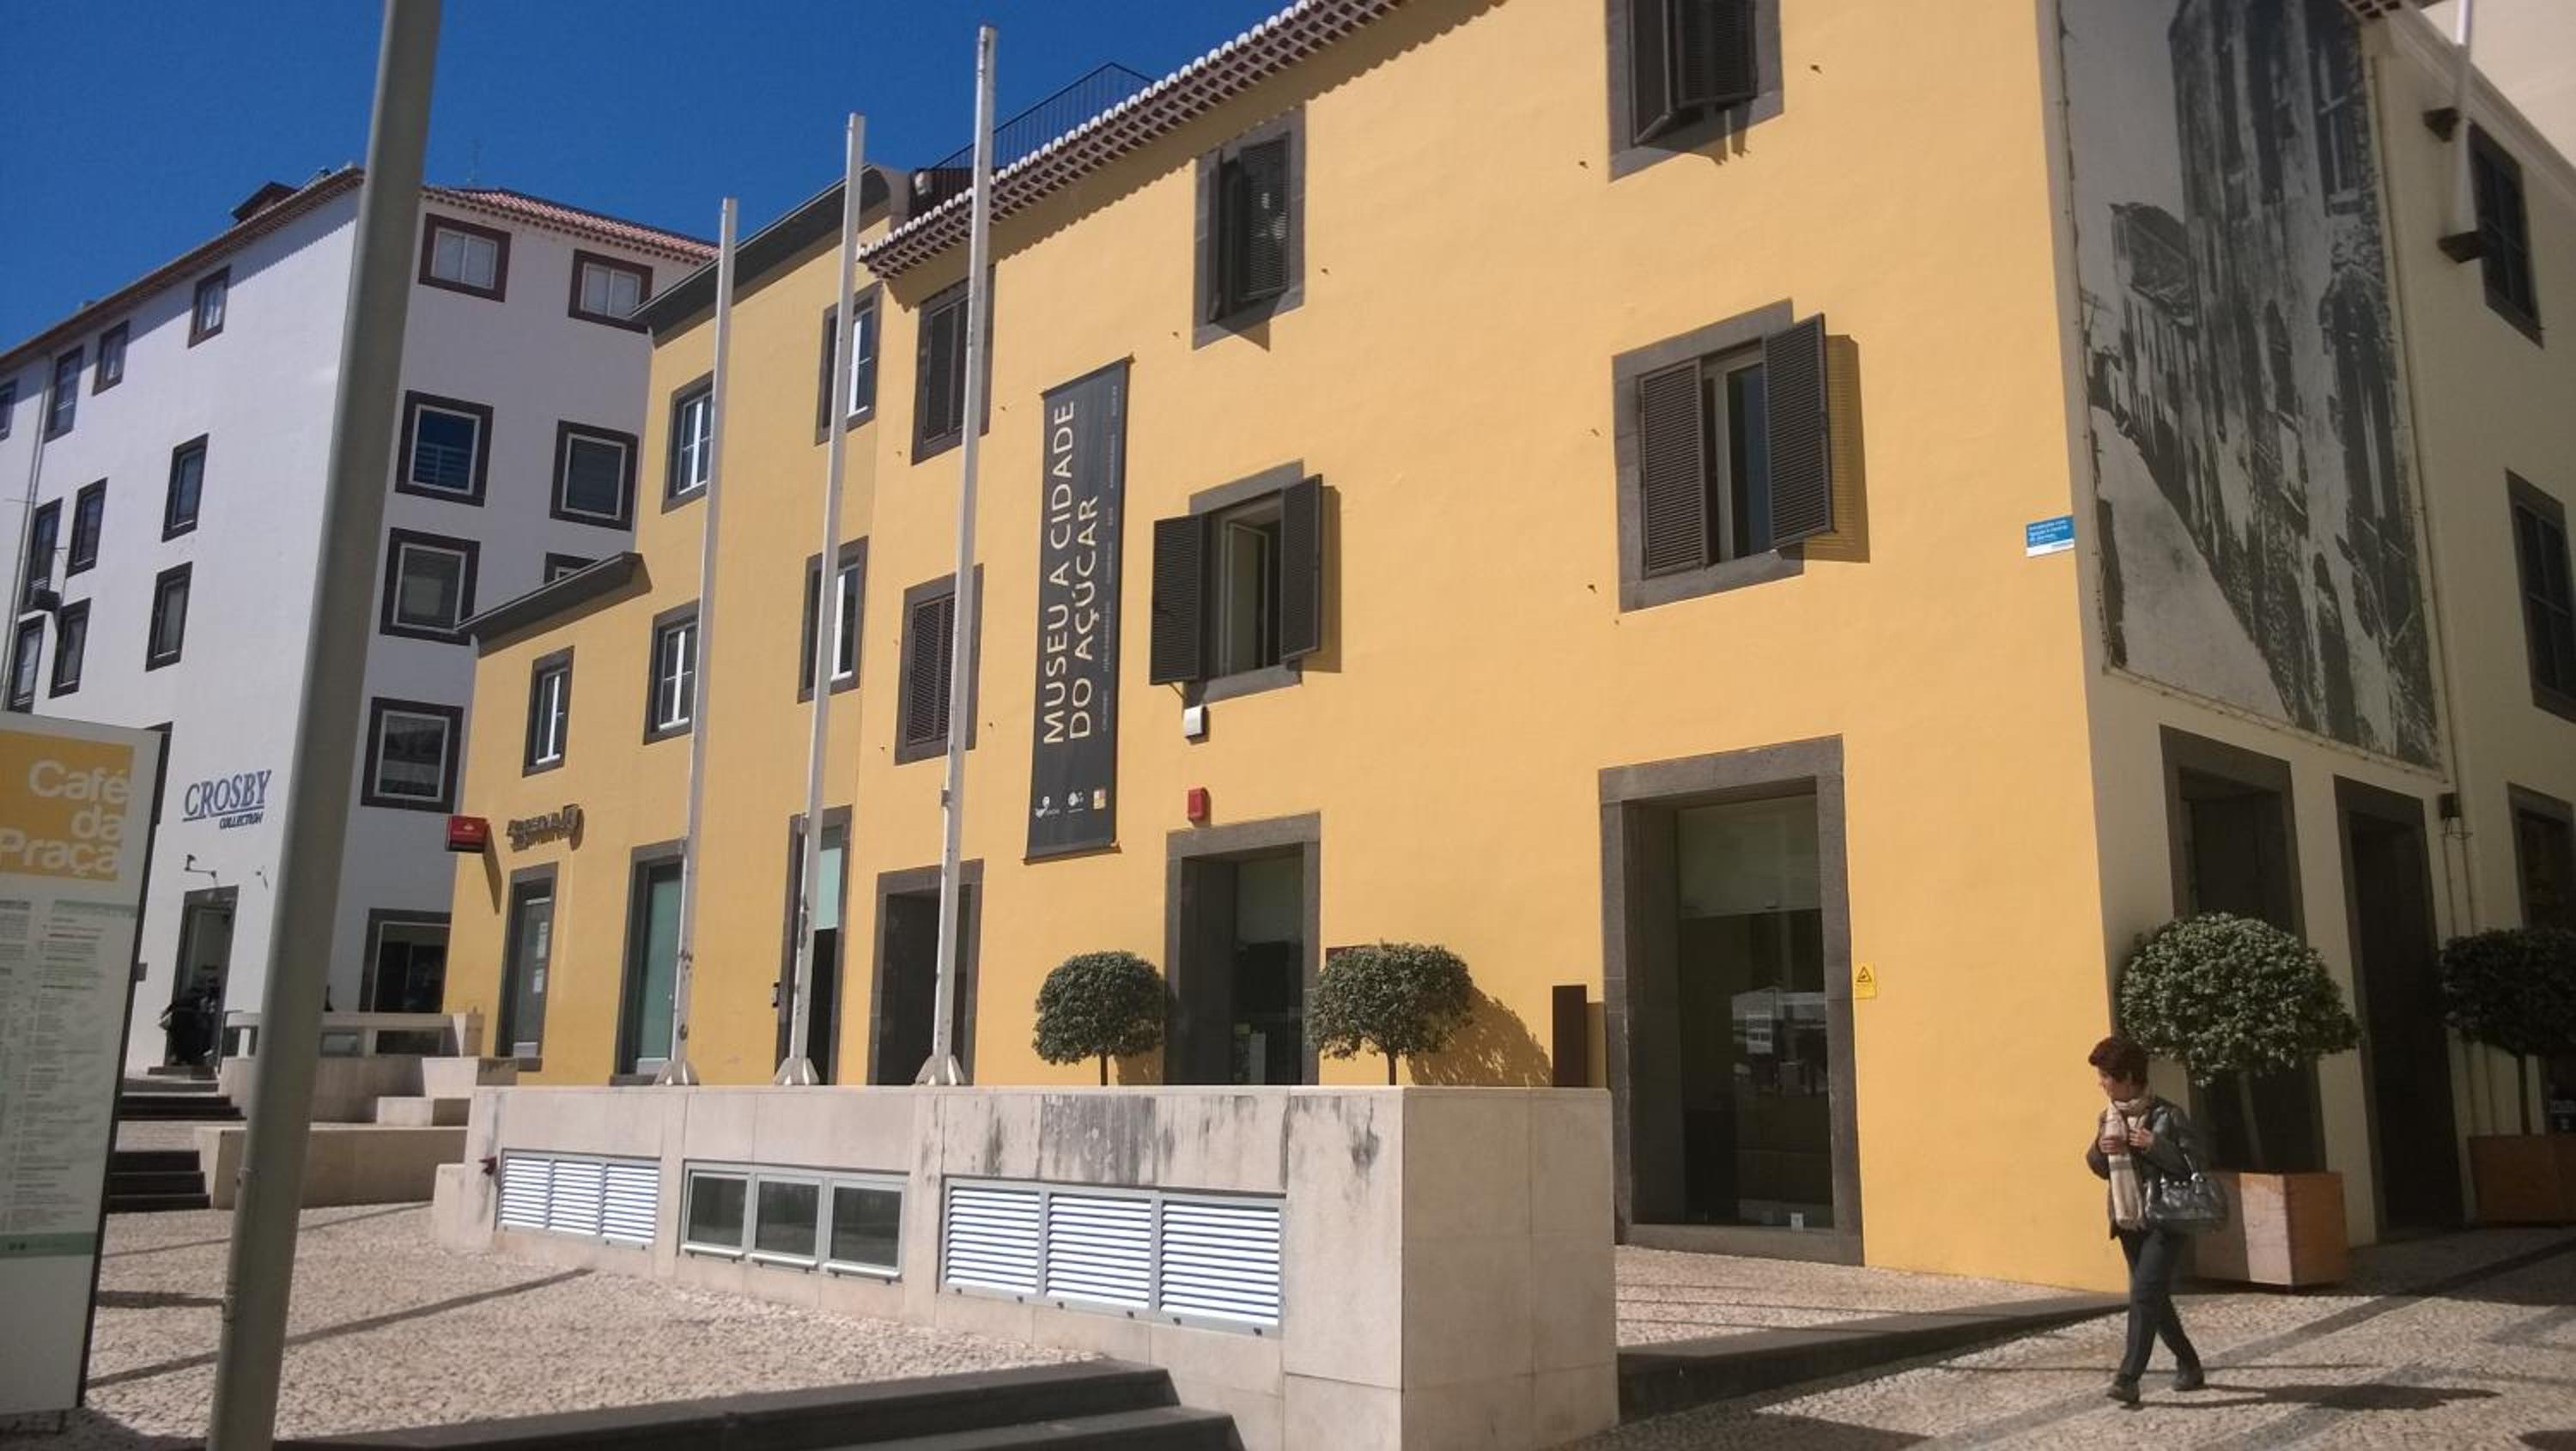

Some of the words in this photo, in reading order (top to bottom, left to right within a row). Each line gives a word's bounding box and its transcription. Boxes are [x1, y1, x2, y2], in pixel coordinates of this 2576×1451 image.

[1050, 401, 1074, 549] CIDADE
[1048, 561, 1071, 586] A
[1072, 495, 1100, 660] AÇÚCAR
[1043, 604, 1069, 744] MUSEU
[1069, 677, 1092, 738] DO
[28, 759, 131, 804] Café
[184, 769, 272, 817] CROSBY
[70, 804, 125, 841] da
[0, 828, 120, 877] Praça
